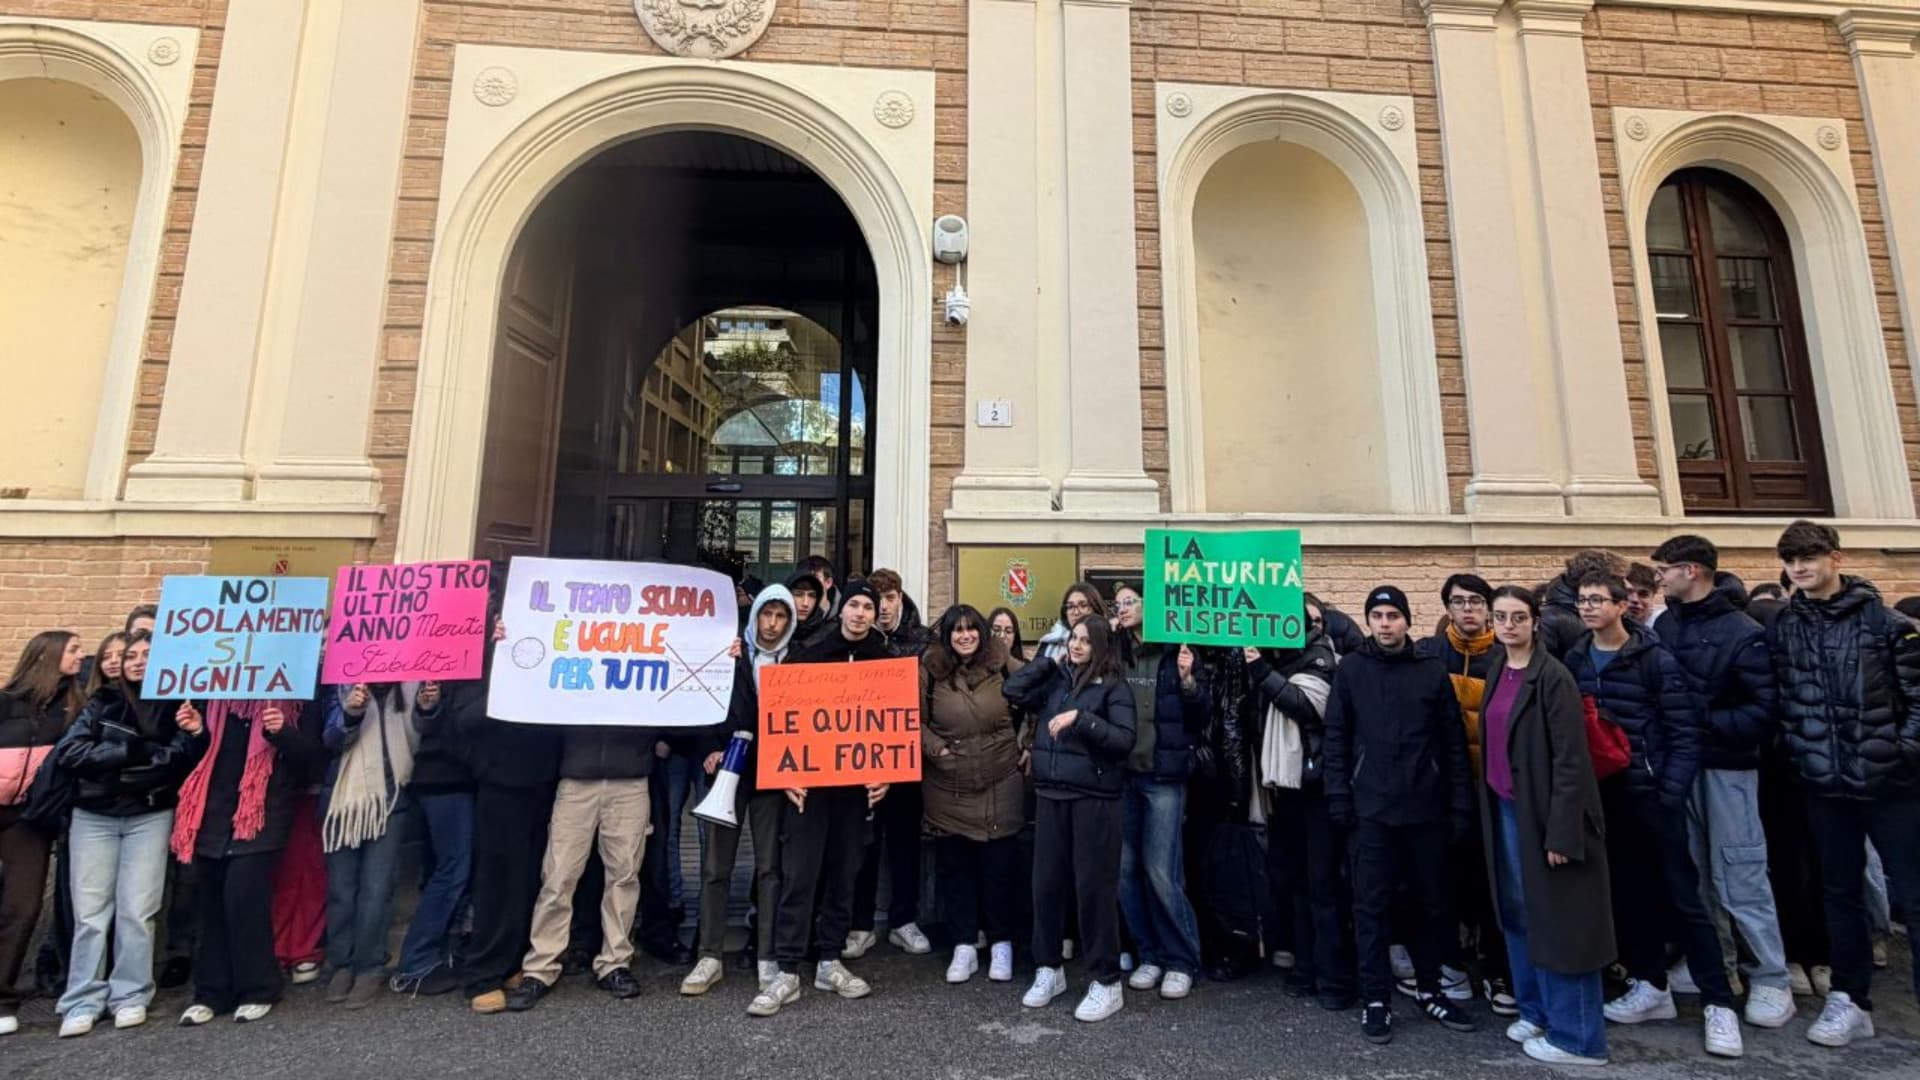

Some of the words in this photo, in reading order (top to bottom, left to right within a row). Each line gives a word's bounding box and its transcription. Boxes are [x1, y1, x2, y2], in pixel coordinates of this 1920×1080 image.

[991, 410, 999, 421] 2
[1164, 536, 1204, 560] LA
[347, 567, 367, 592] IL
[378, 564, 488, 591] NOSTRO
[1164, 558, 1302, 587] MATURITÀ
[343, 591, 428, 617] ULTIMO
[529, 580, 556, 613] IL
[638, 584, 715, 617] SCUOLA
[1164, 584, 1257, 609] MERITA
[164, 607, 324, 636] ISOLAMENTO
[335, 616, 411, 642] ANNO
[1165, 609, 1301, 639] RISPETTO
[577, 621, 669, 655] UGUALE
[156, 662, 293, 697] DIGNITÀ
[549, 657, 595, 691] PER
[601, 658, 670, 691] TUTTI
[767, 711, 799, 735] LE
[812, 705, 919, 733] QUINTE
[777, 745, 820, 772] AL
[835, 741, 915, 771] FORTI
